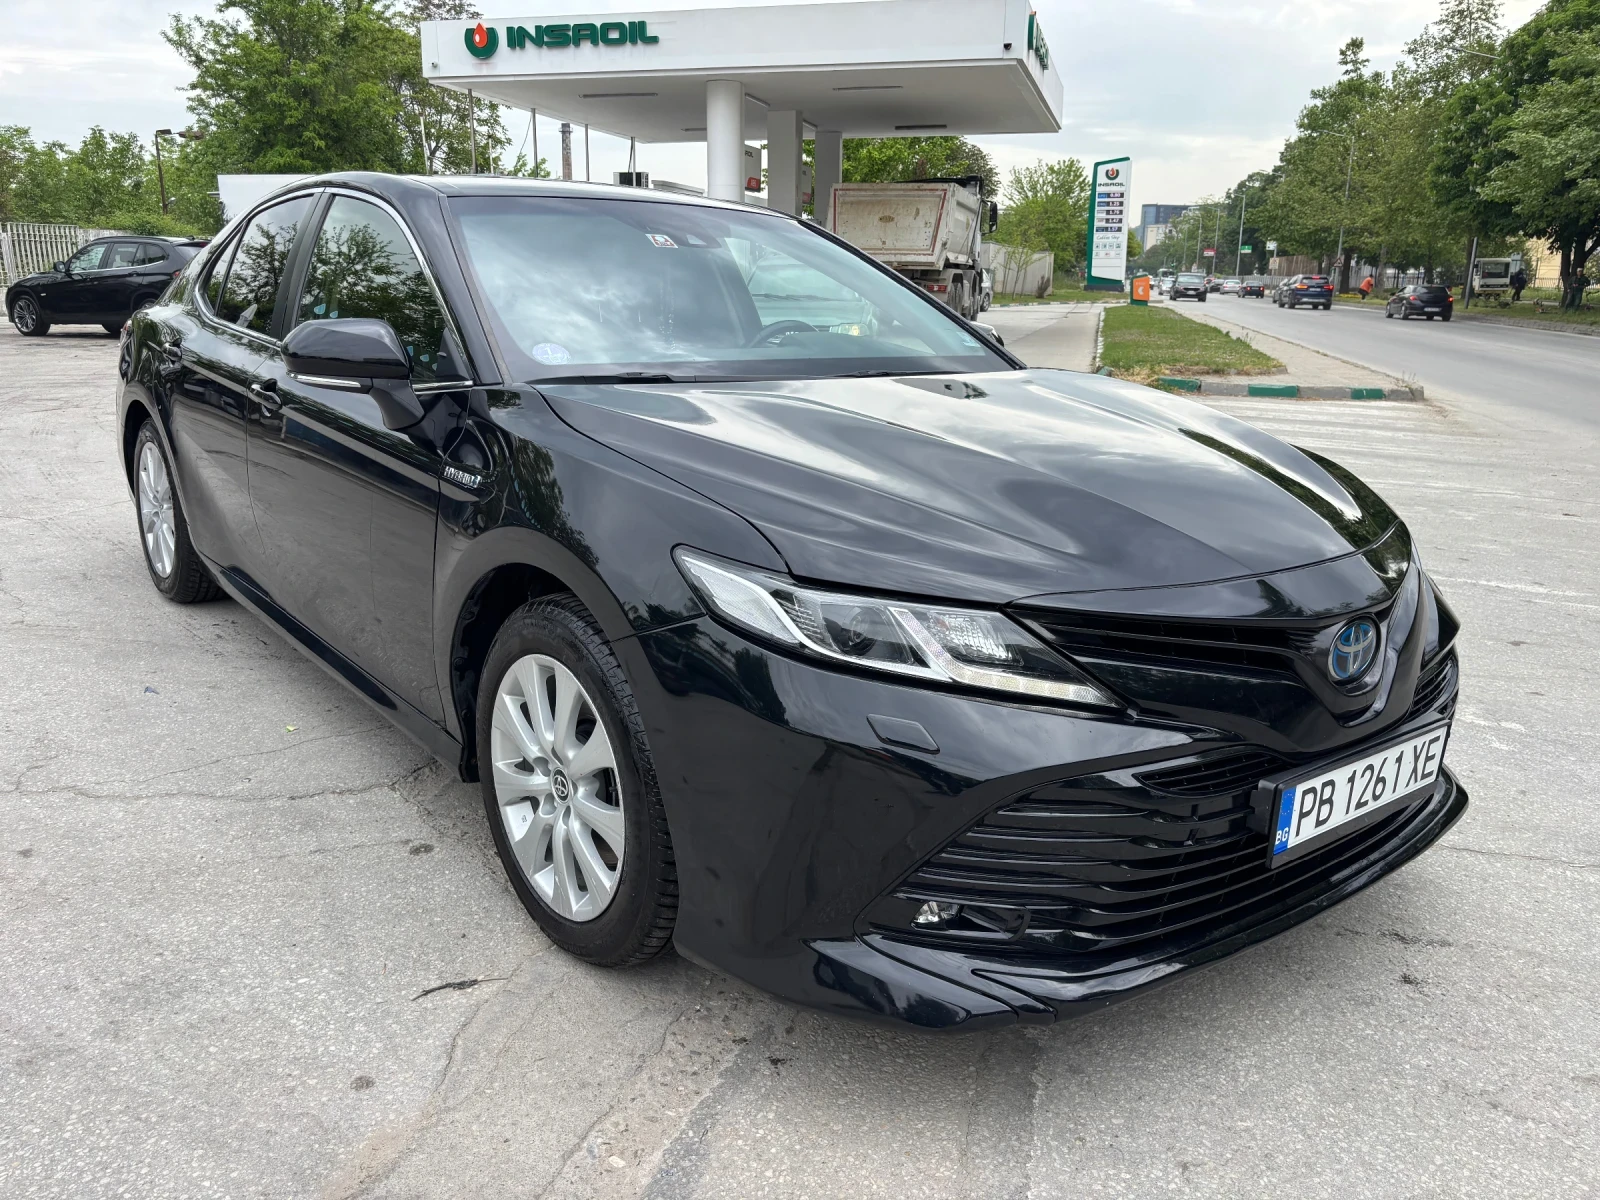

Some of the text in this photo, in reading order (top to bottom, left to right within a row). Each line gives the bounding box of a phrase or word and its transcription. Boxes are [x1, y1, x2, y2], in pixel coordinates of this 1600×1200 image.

[507, 20, 659, 49] INSAOIL
[1295, 735, 1441, 839] PB 1261 XE
[1275, 827, 1290, 845] BG
